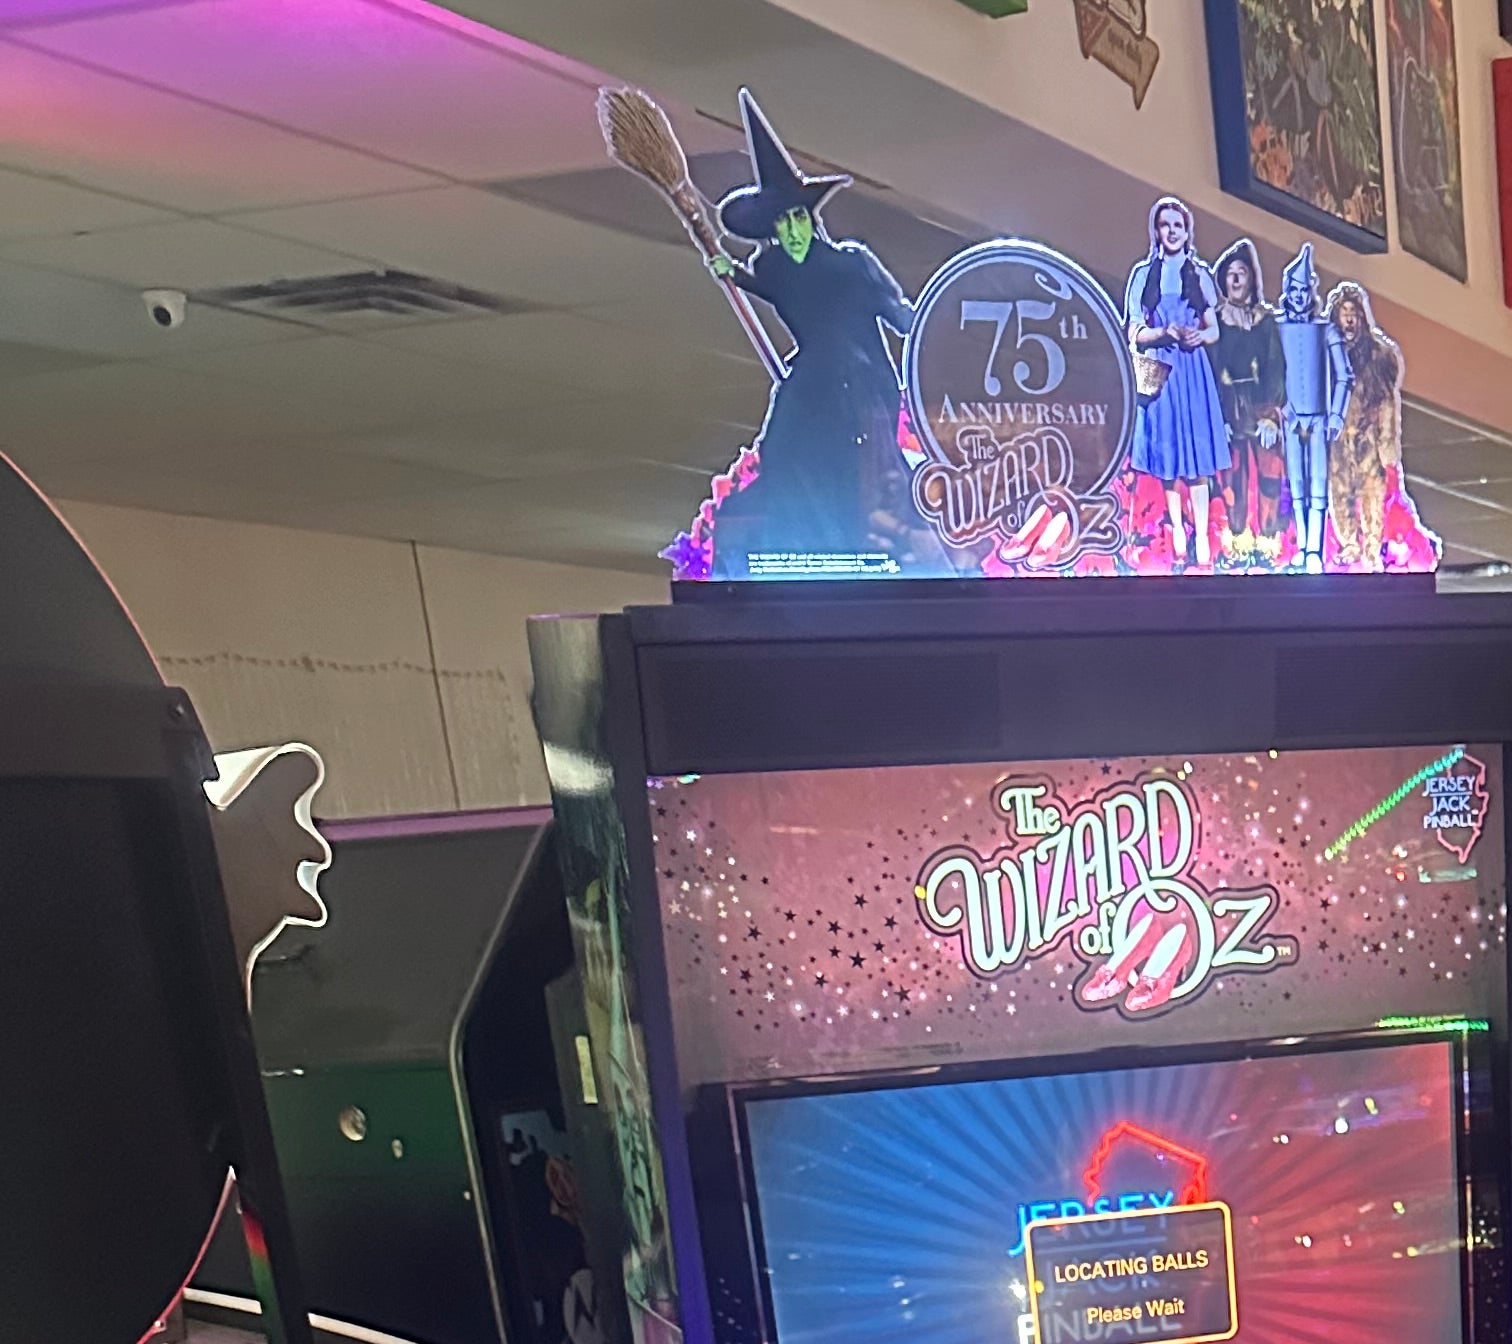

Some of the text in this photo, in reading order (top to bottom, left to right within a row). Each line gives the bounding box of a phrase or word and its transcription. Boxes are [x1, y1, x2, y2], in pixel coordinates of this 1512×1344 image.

[938, 400, 1110, 429] ANNIVERSARY
[922, 434, 1071, 525] WIZARD
[1422, 776, 1475, 796] JERSEY
[1005, 786, 1063, 838] The
[1429, 796, 1470, 816] JACK
[1423, 814, 1474, 829] PINBALL
[925, 778, 1194, 972] WIZARD
[1054, 1250, 1209, 1283] LOCATING BALLS
[1087, 1298, 1185, 1324] Please Wait
